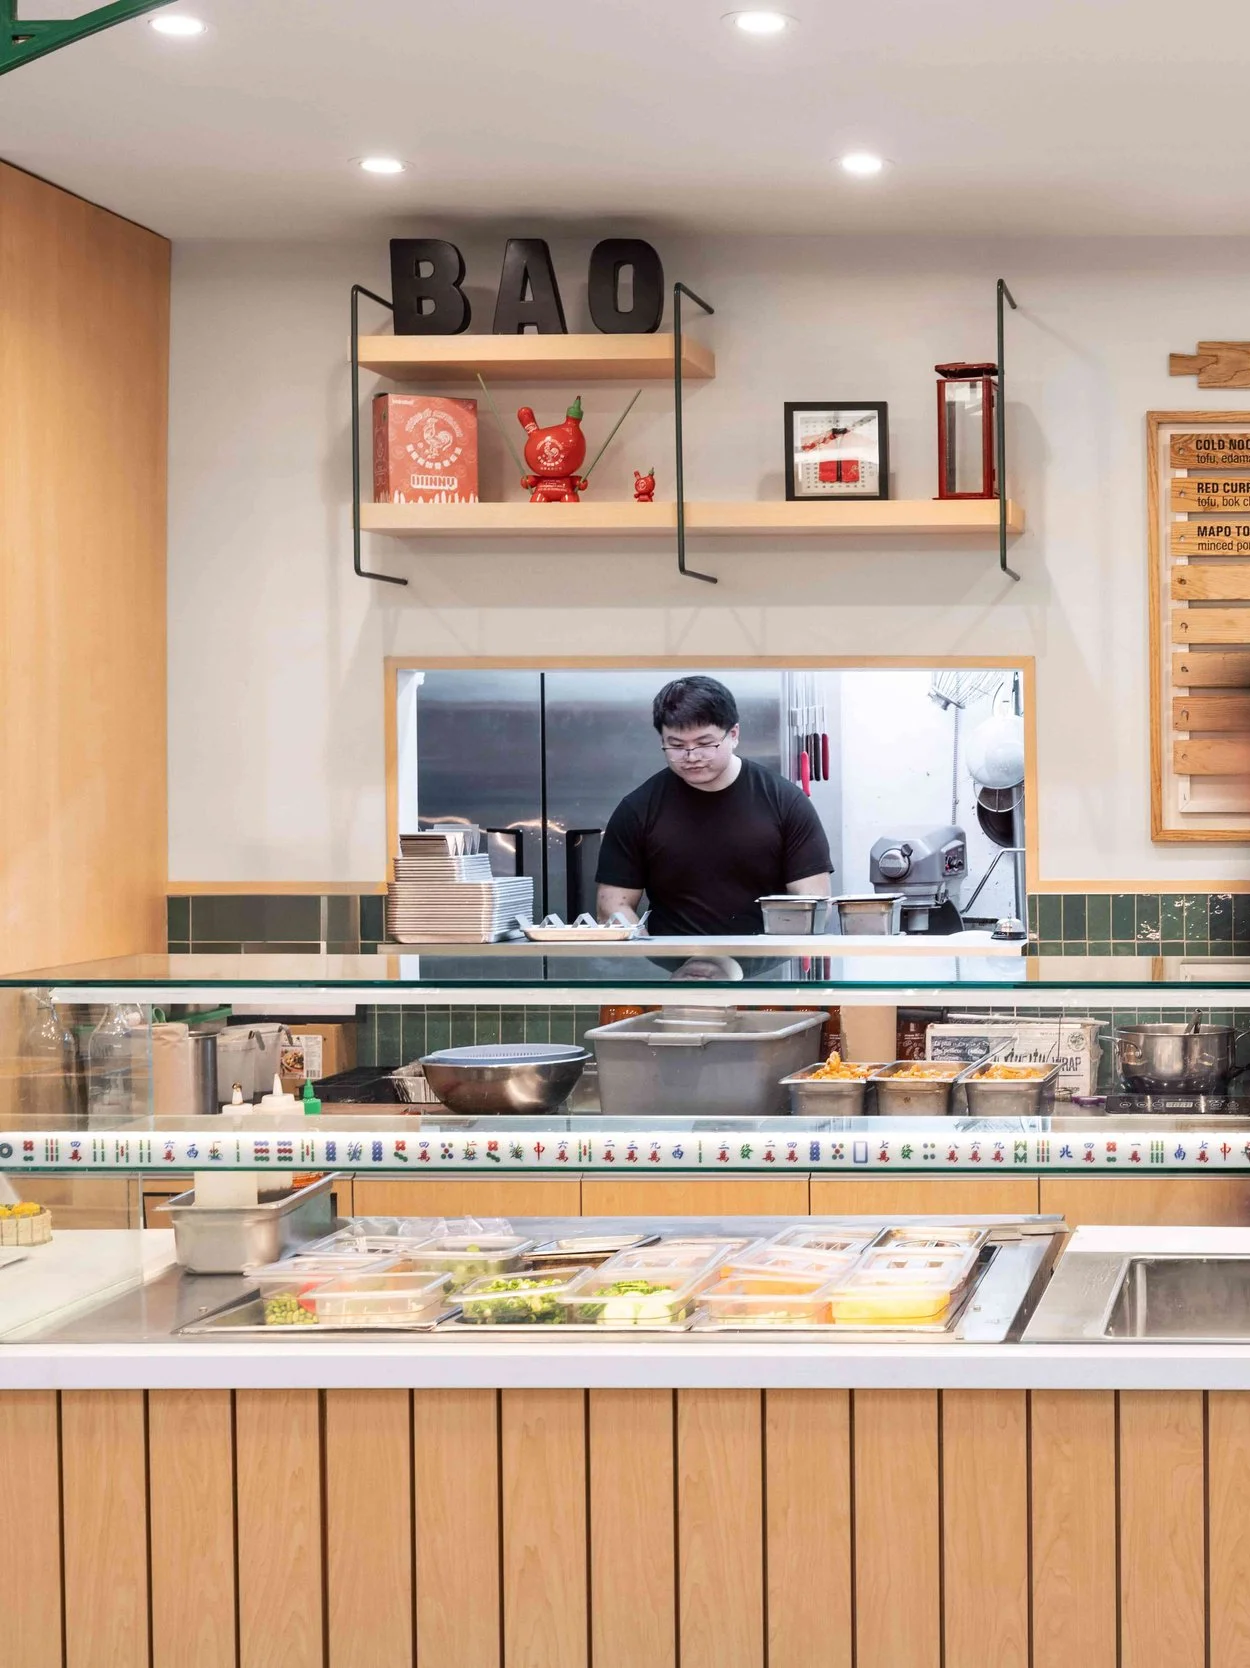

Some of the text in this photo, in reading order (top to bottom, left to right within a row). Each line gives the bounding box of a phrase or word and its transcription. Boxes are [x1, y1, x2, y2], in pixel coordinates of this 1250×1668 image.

[390, 239, 664, 335] BAO
[1196, 438, 1225, 450] COLD
[1196, 452, 1218, 464] tofu,
[1197, 483, 1220, 494] RED
[1197, 496, 1219, 508] tofu,
[1222, 496, 1240, 506] bok
[1197, 526, 1231, 537] MAPO
